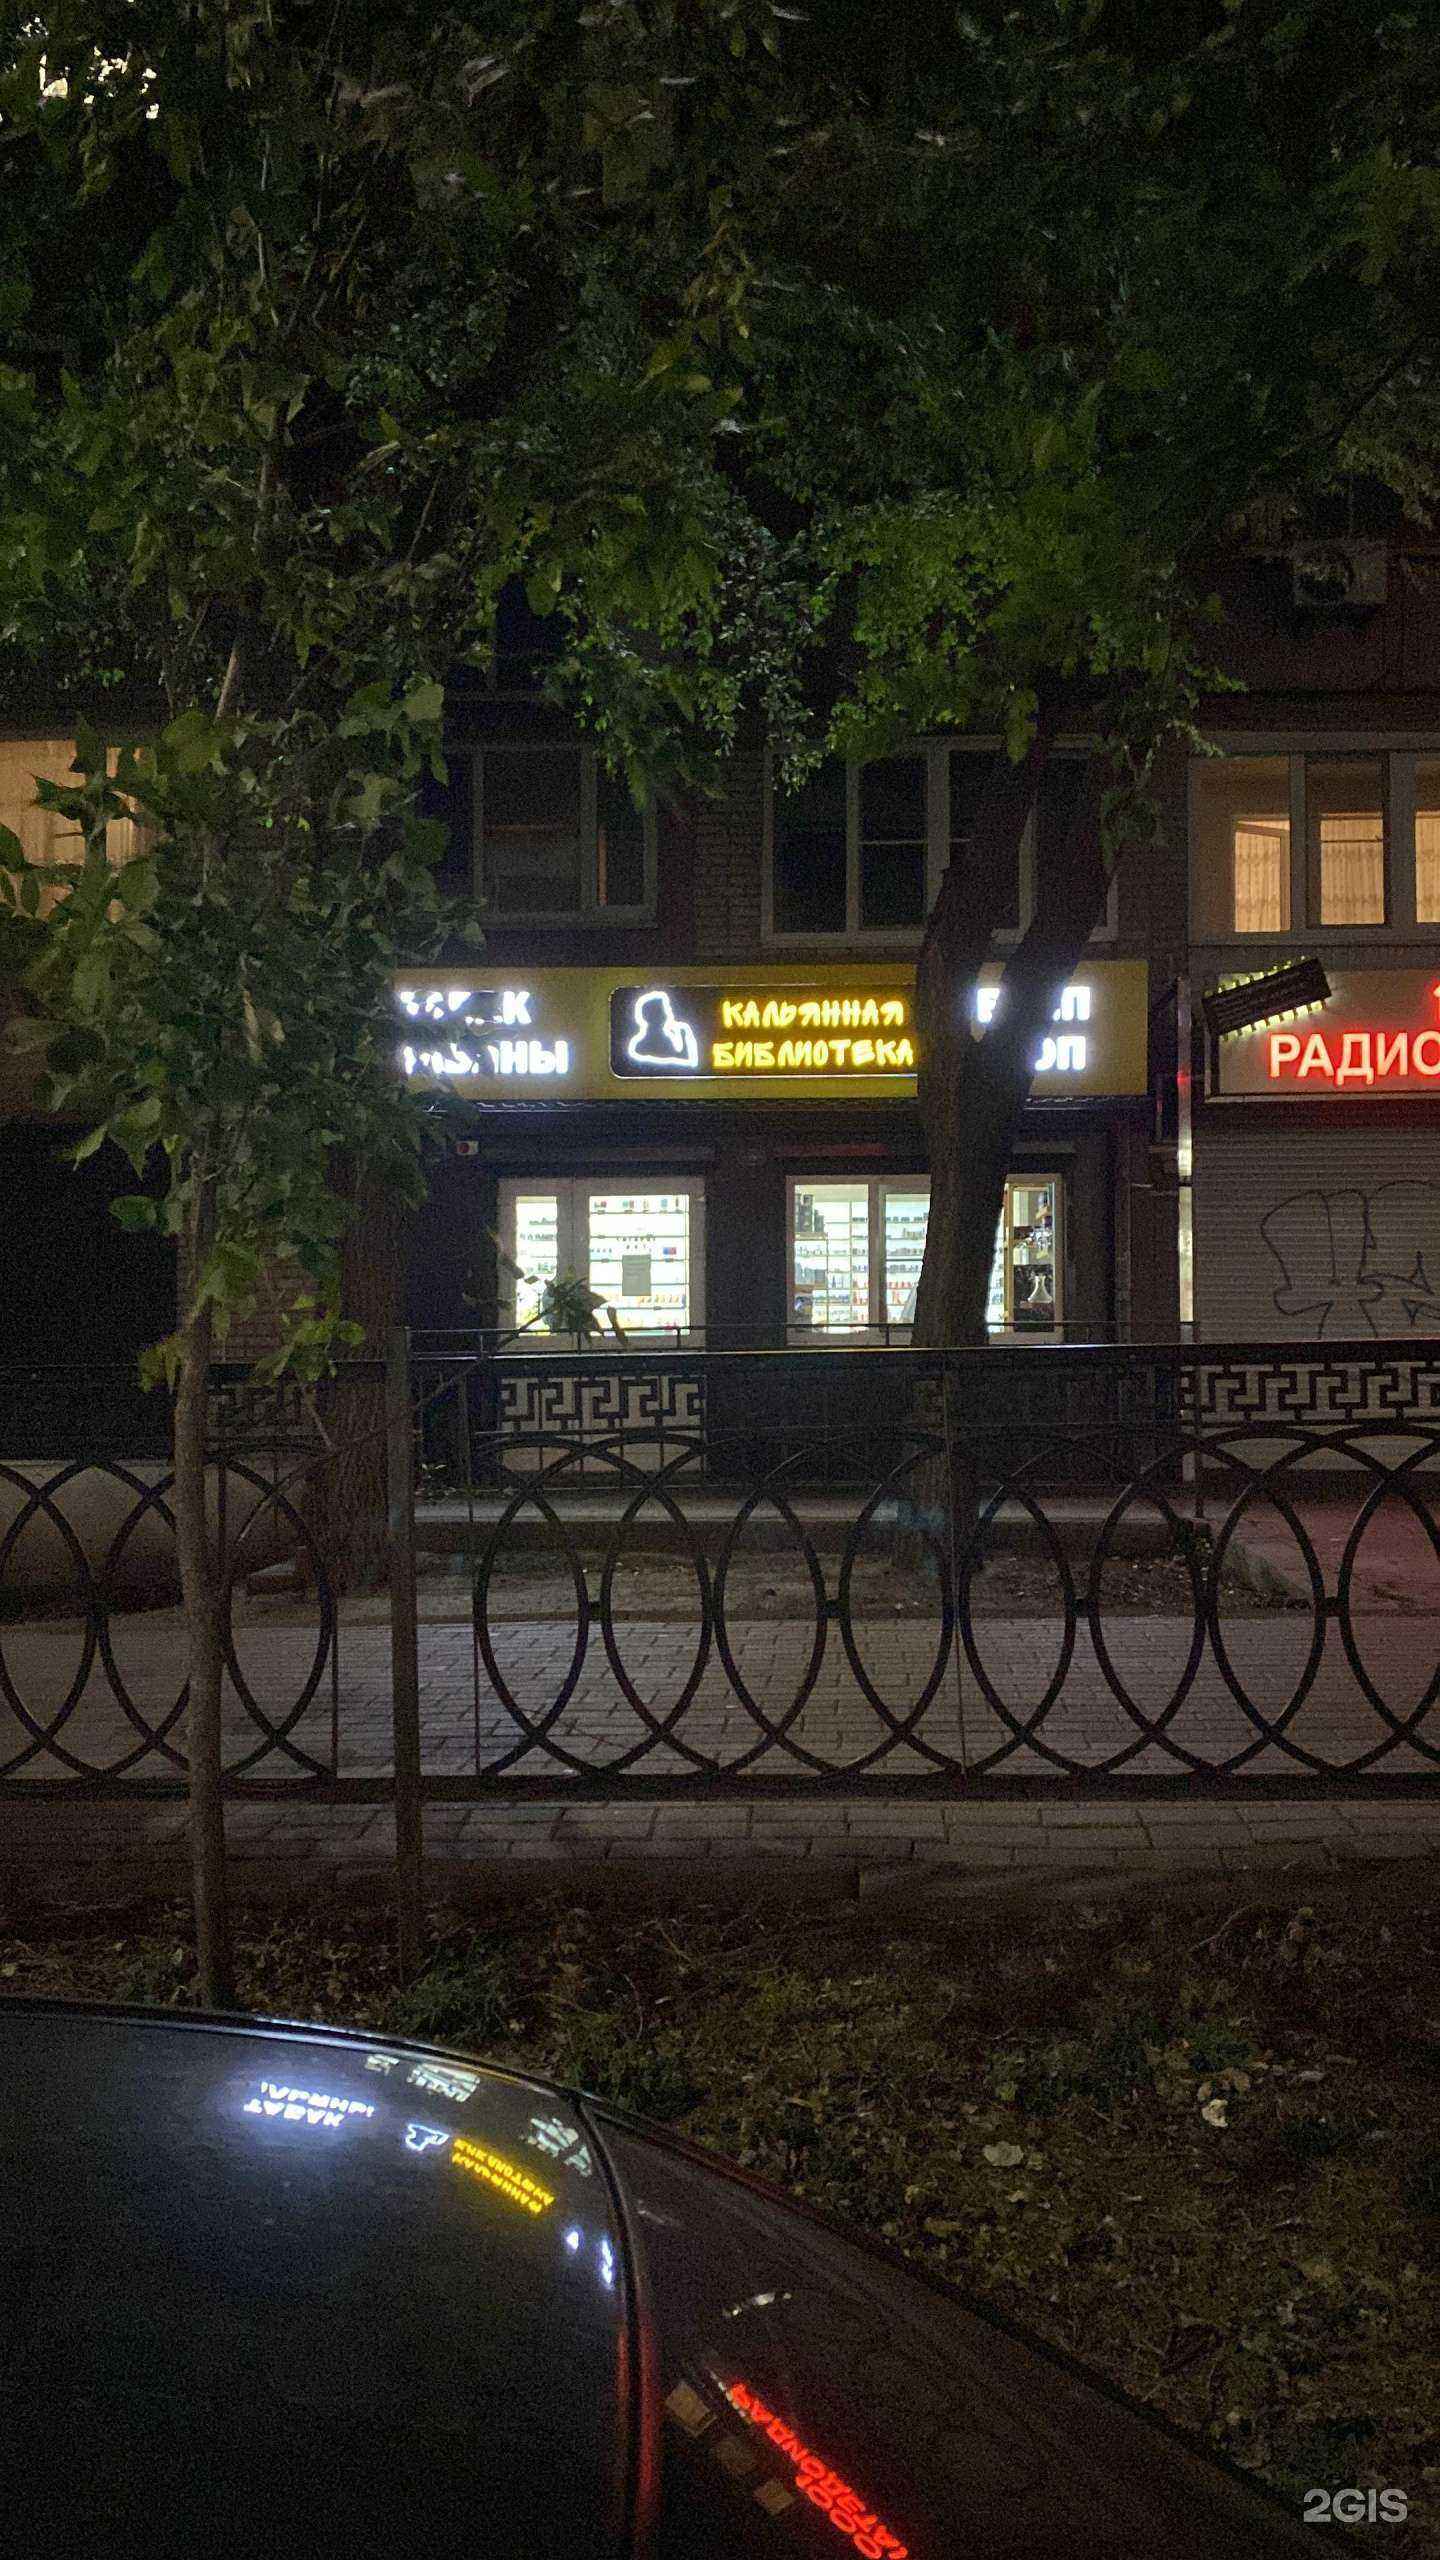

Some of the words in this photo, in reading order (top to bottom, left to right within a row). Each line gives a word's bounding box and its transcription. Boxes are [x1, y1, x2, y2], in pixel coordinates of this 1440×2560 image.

[722, 999, 905, 1029] КАЛЬЯННАЯ
[712, 1039, 914, 1068] БИБЛИОТЕКА
[1269, 1031, 1440, 1086] РАДИО
